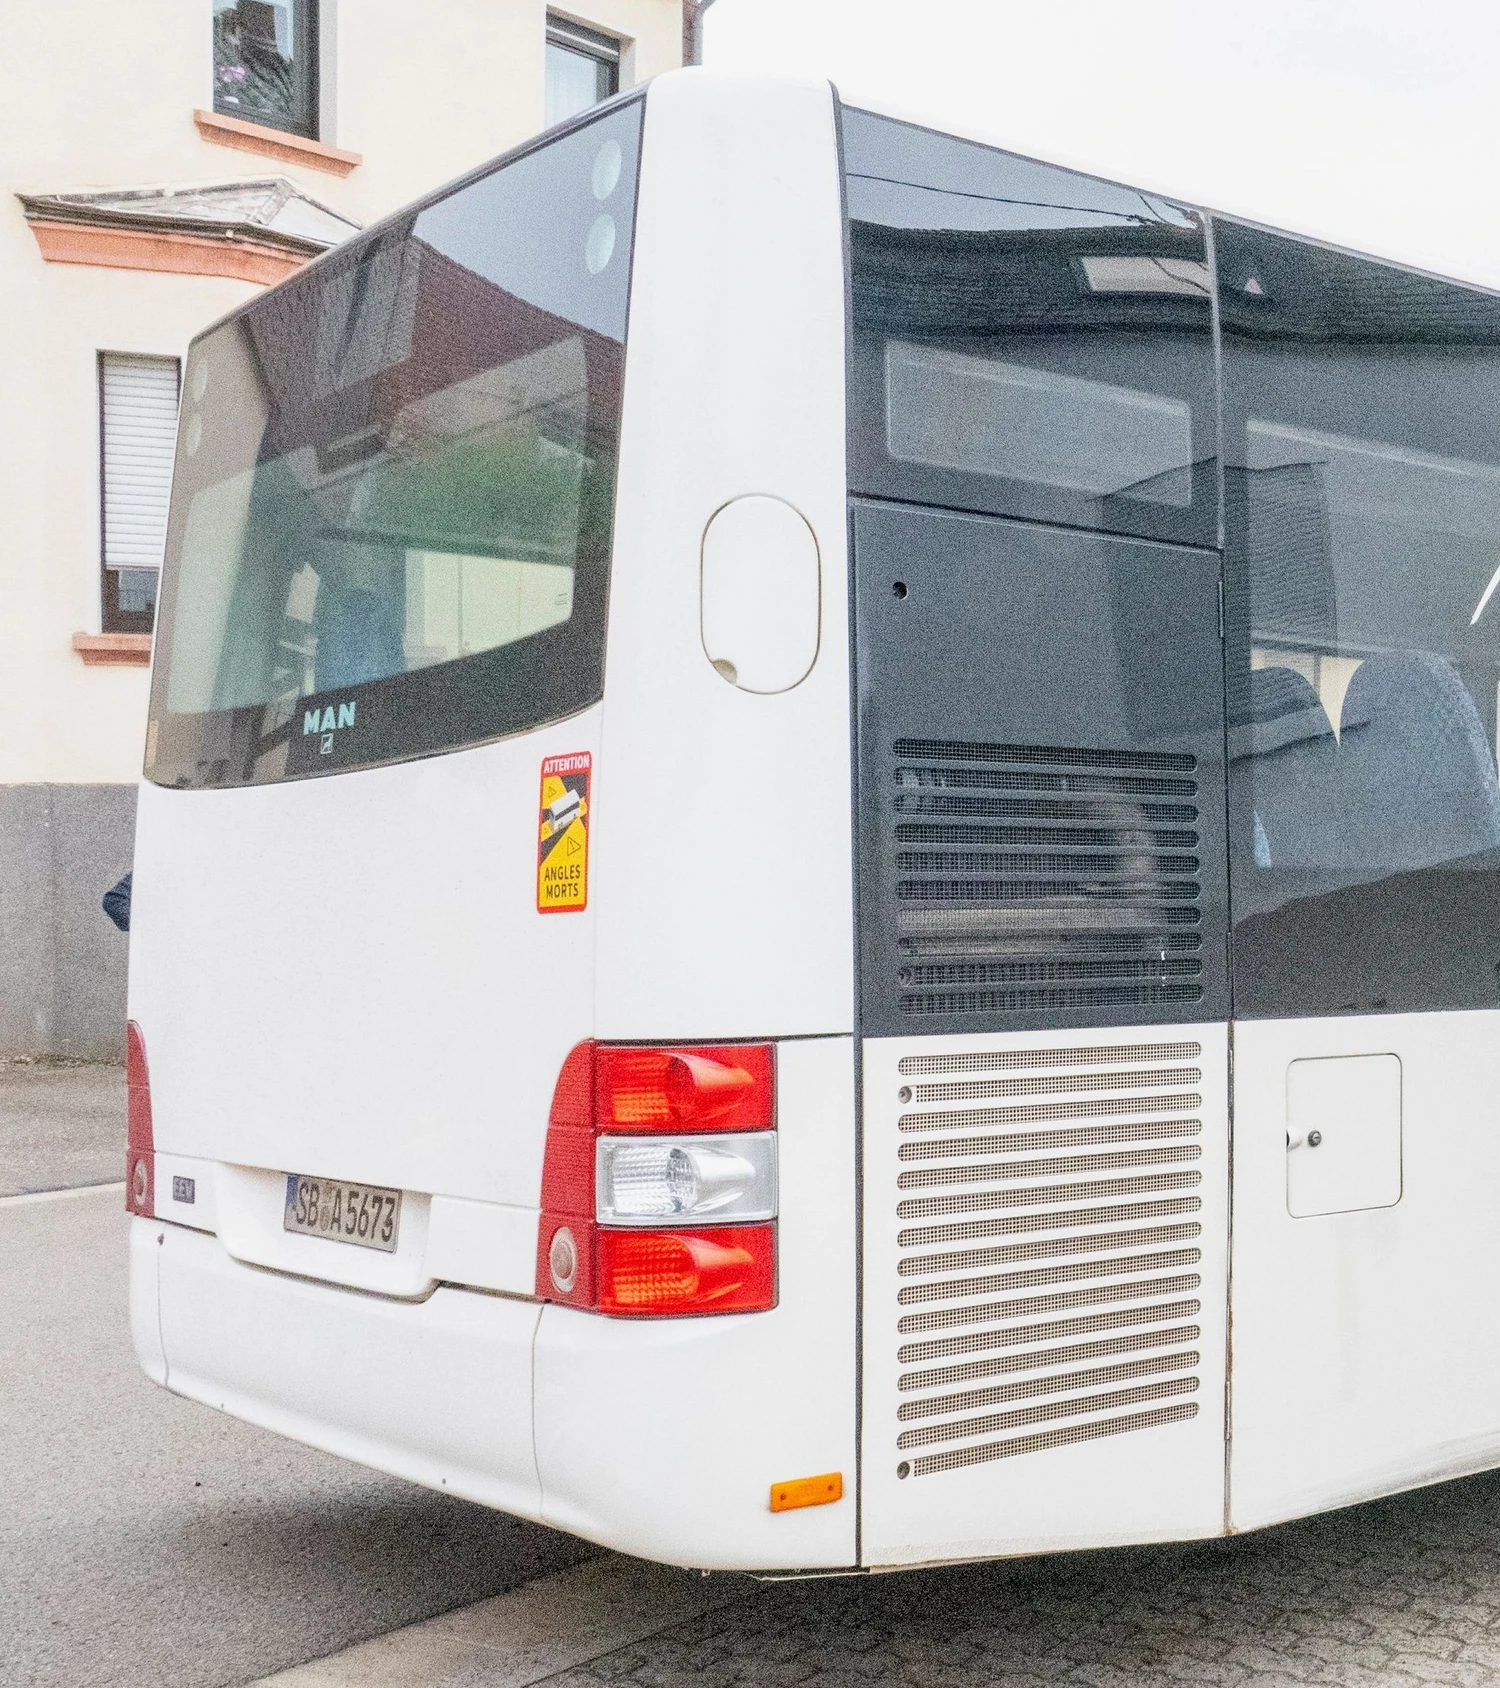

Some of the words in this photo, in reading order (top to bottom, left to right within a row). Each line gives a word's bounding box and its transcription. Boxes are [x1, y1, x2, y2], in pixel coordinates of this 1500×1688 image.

[303, 701, 356, 735] MAN
[543, 755, 590, 773] ATTENTION
[544, 864, 581, 881] ANGLES
[546, 883, 579, 898] MORTS
[296, 1181, 319, 1227] SB
